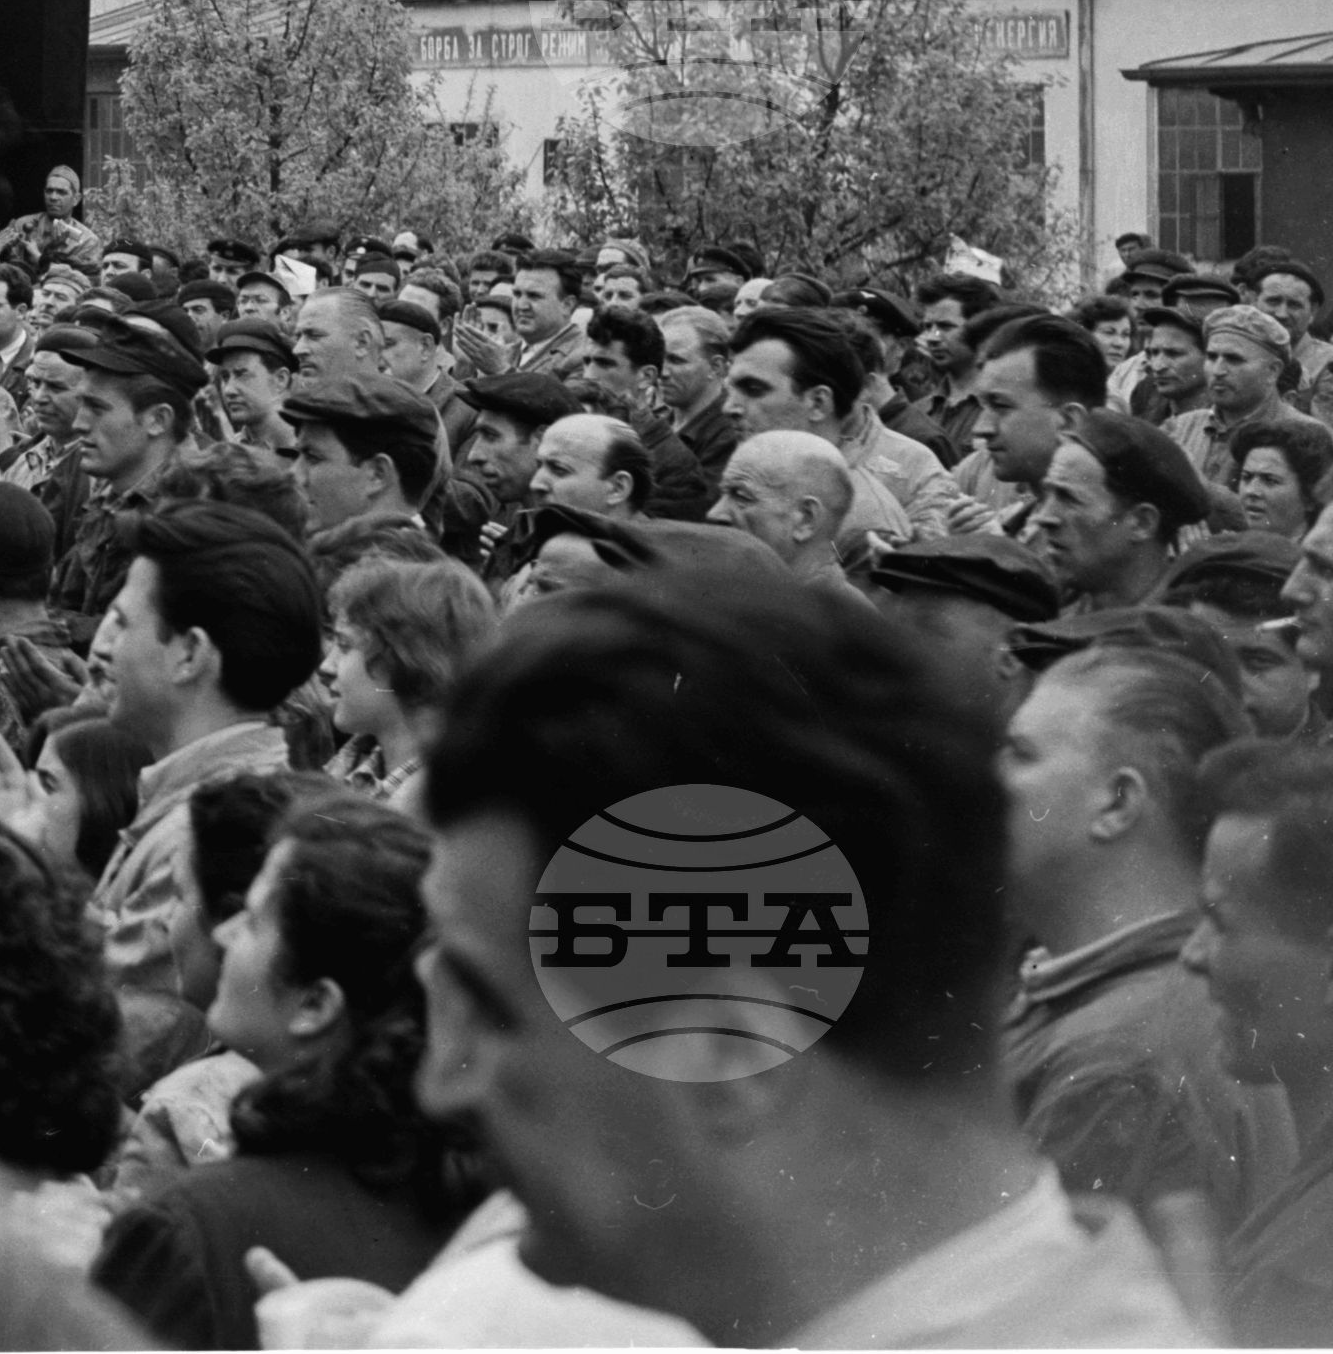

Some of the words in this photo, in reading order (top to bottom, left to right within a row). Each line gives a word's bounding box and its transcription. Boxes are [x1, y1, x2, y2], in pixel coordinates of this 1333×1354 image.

[420, 35, 459, 62] БОРБА
[468, 34, 483, 59] ЗА
[491, 32, 532, 59] СТРОГ
[541, 31, 587, 58] РЕЖИМ
